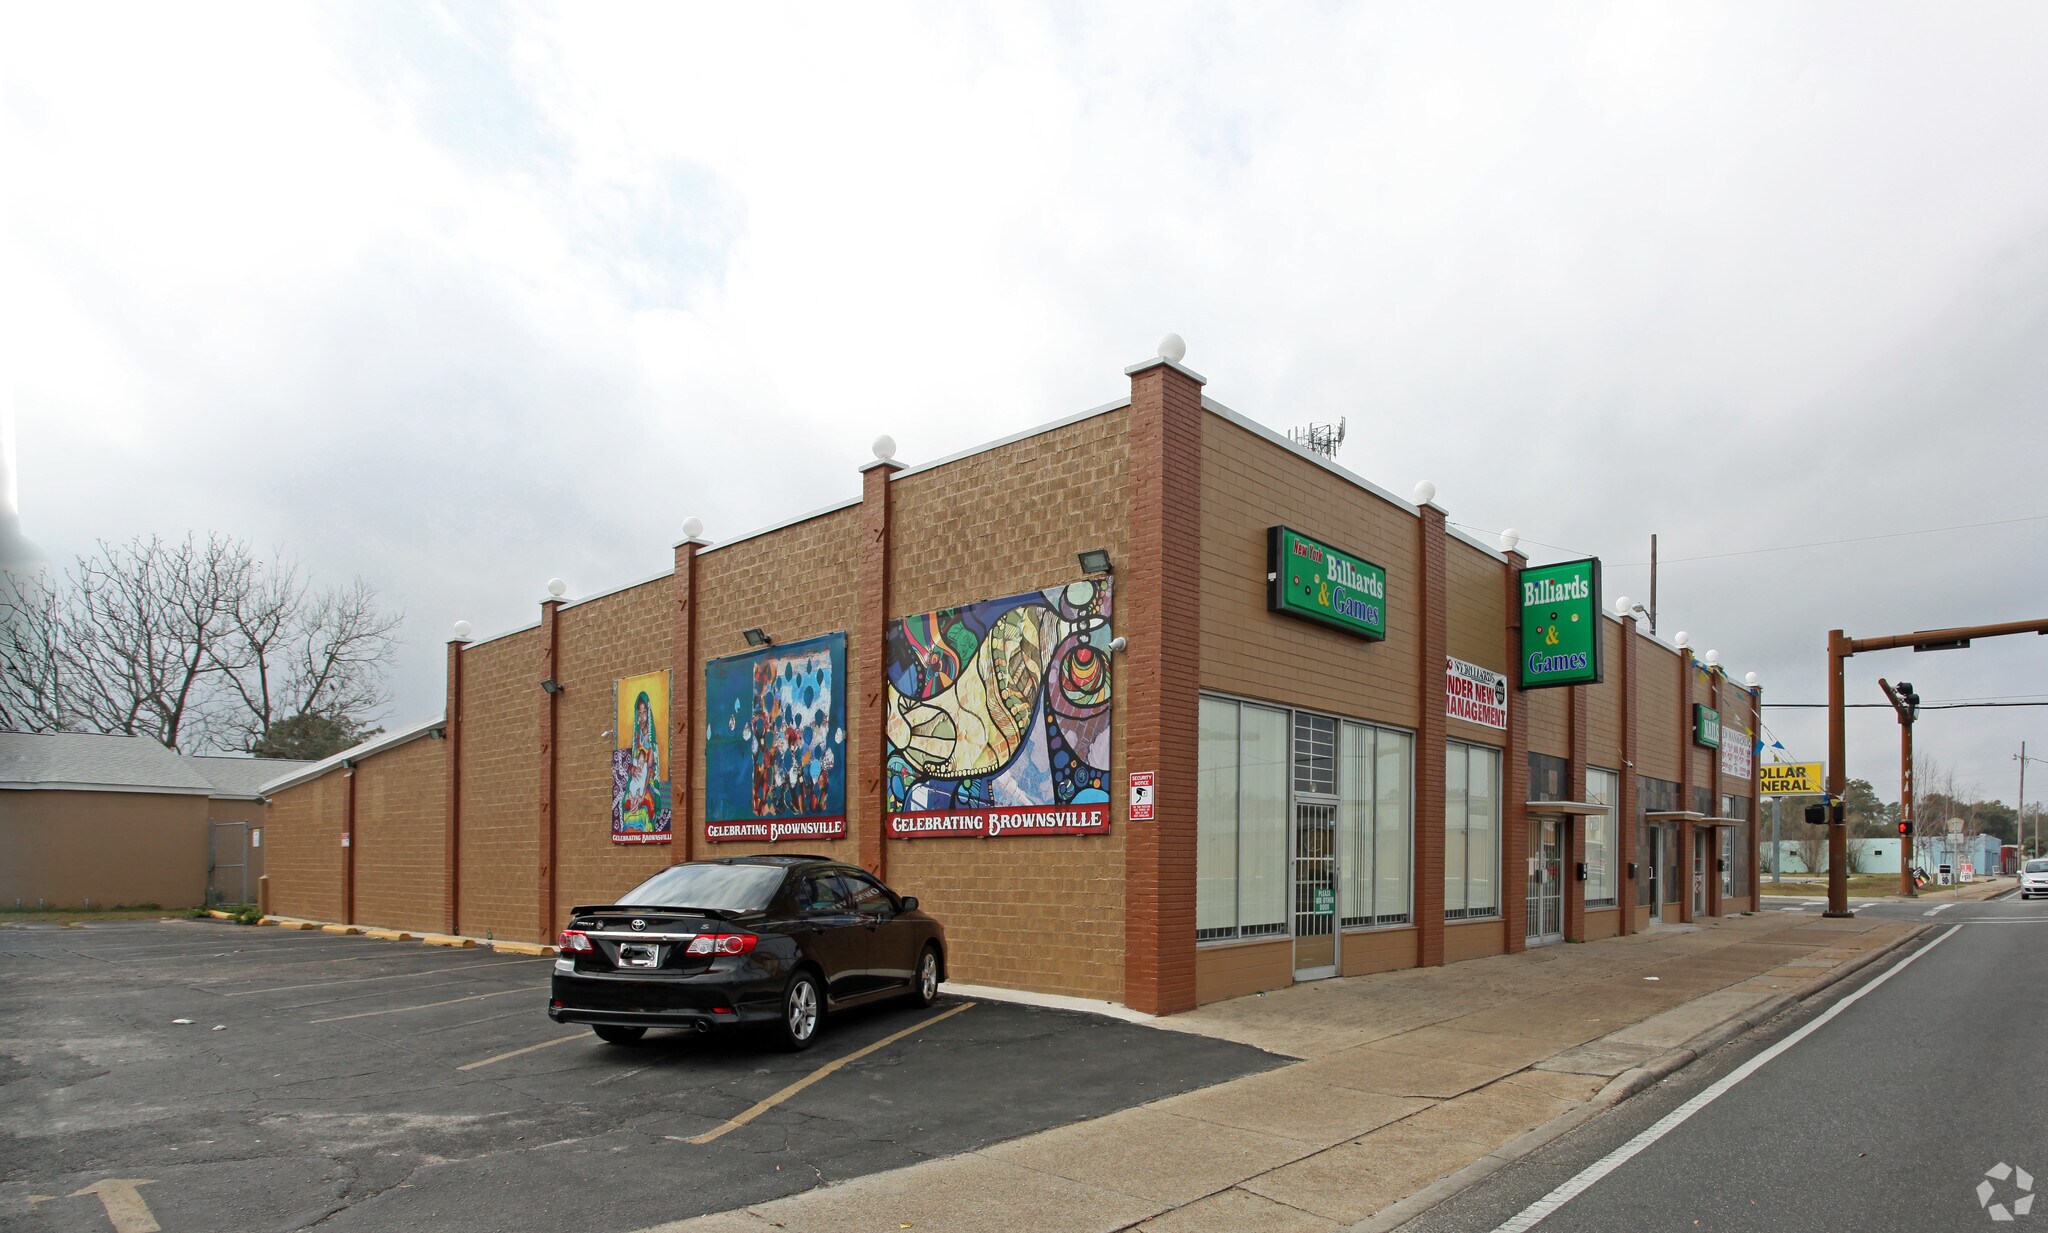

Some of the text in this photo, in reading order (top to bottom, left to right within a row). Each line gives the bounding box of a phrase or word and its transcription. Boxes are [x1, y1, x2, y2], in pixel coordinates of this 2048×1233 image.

[1293, 537, 1323, 564] New York
[1326, 553, 1383, 600] Billiards
[1524, 575, 1589, 607] Billiards
[1318, 582, 1379, 625] & Games
[1545, 625, 1559, 645] &
[1528, 651, 1587, 675] Games
[1446, 675, 1473, 700] NDER
[1475, 683, 1495, 706] NEW
[1760, 767, 1806, 779] OLLAR
[1761, 780, 1811, 791] NERAL
[707, 821, 842, 841] CELEBRATING BROWNSVILLE
[892, 811, 1102, 836] CELEBRATING BROWNSVILLE
[612, 833, 672, 844] CELEBRATING BROWNSVILL
